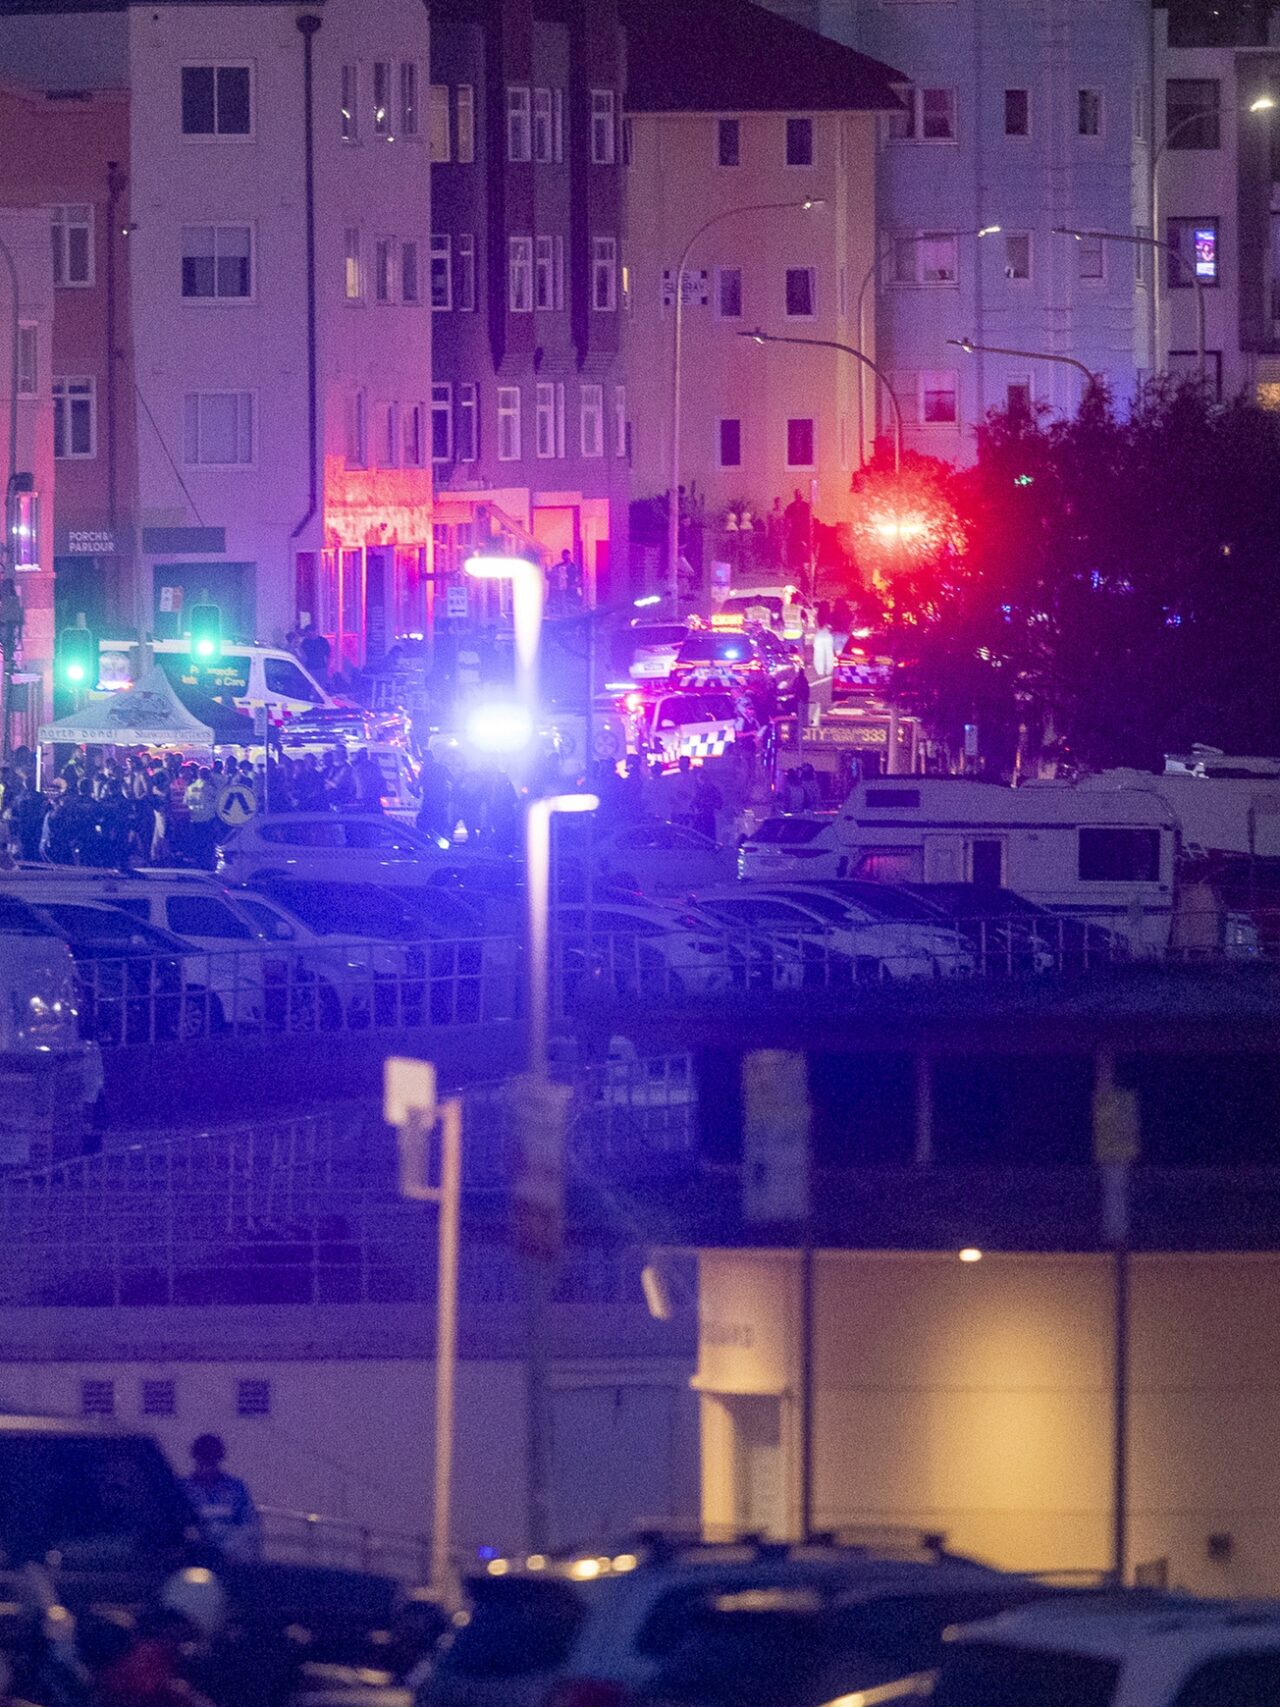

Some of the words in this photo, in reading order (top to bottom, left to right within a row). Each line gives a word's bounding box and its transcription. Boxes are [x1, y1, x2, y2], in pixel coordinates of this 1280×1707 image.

[664, 282, 705, 294] SRAY
[69, 542, 114, 552] PARLOUR
[40, 729, 75, 738] north
[81, 729, 118, 739] bondi
[862, 728, 887, 742] 333
